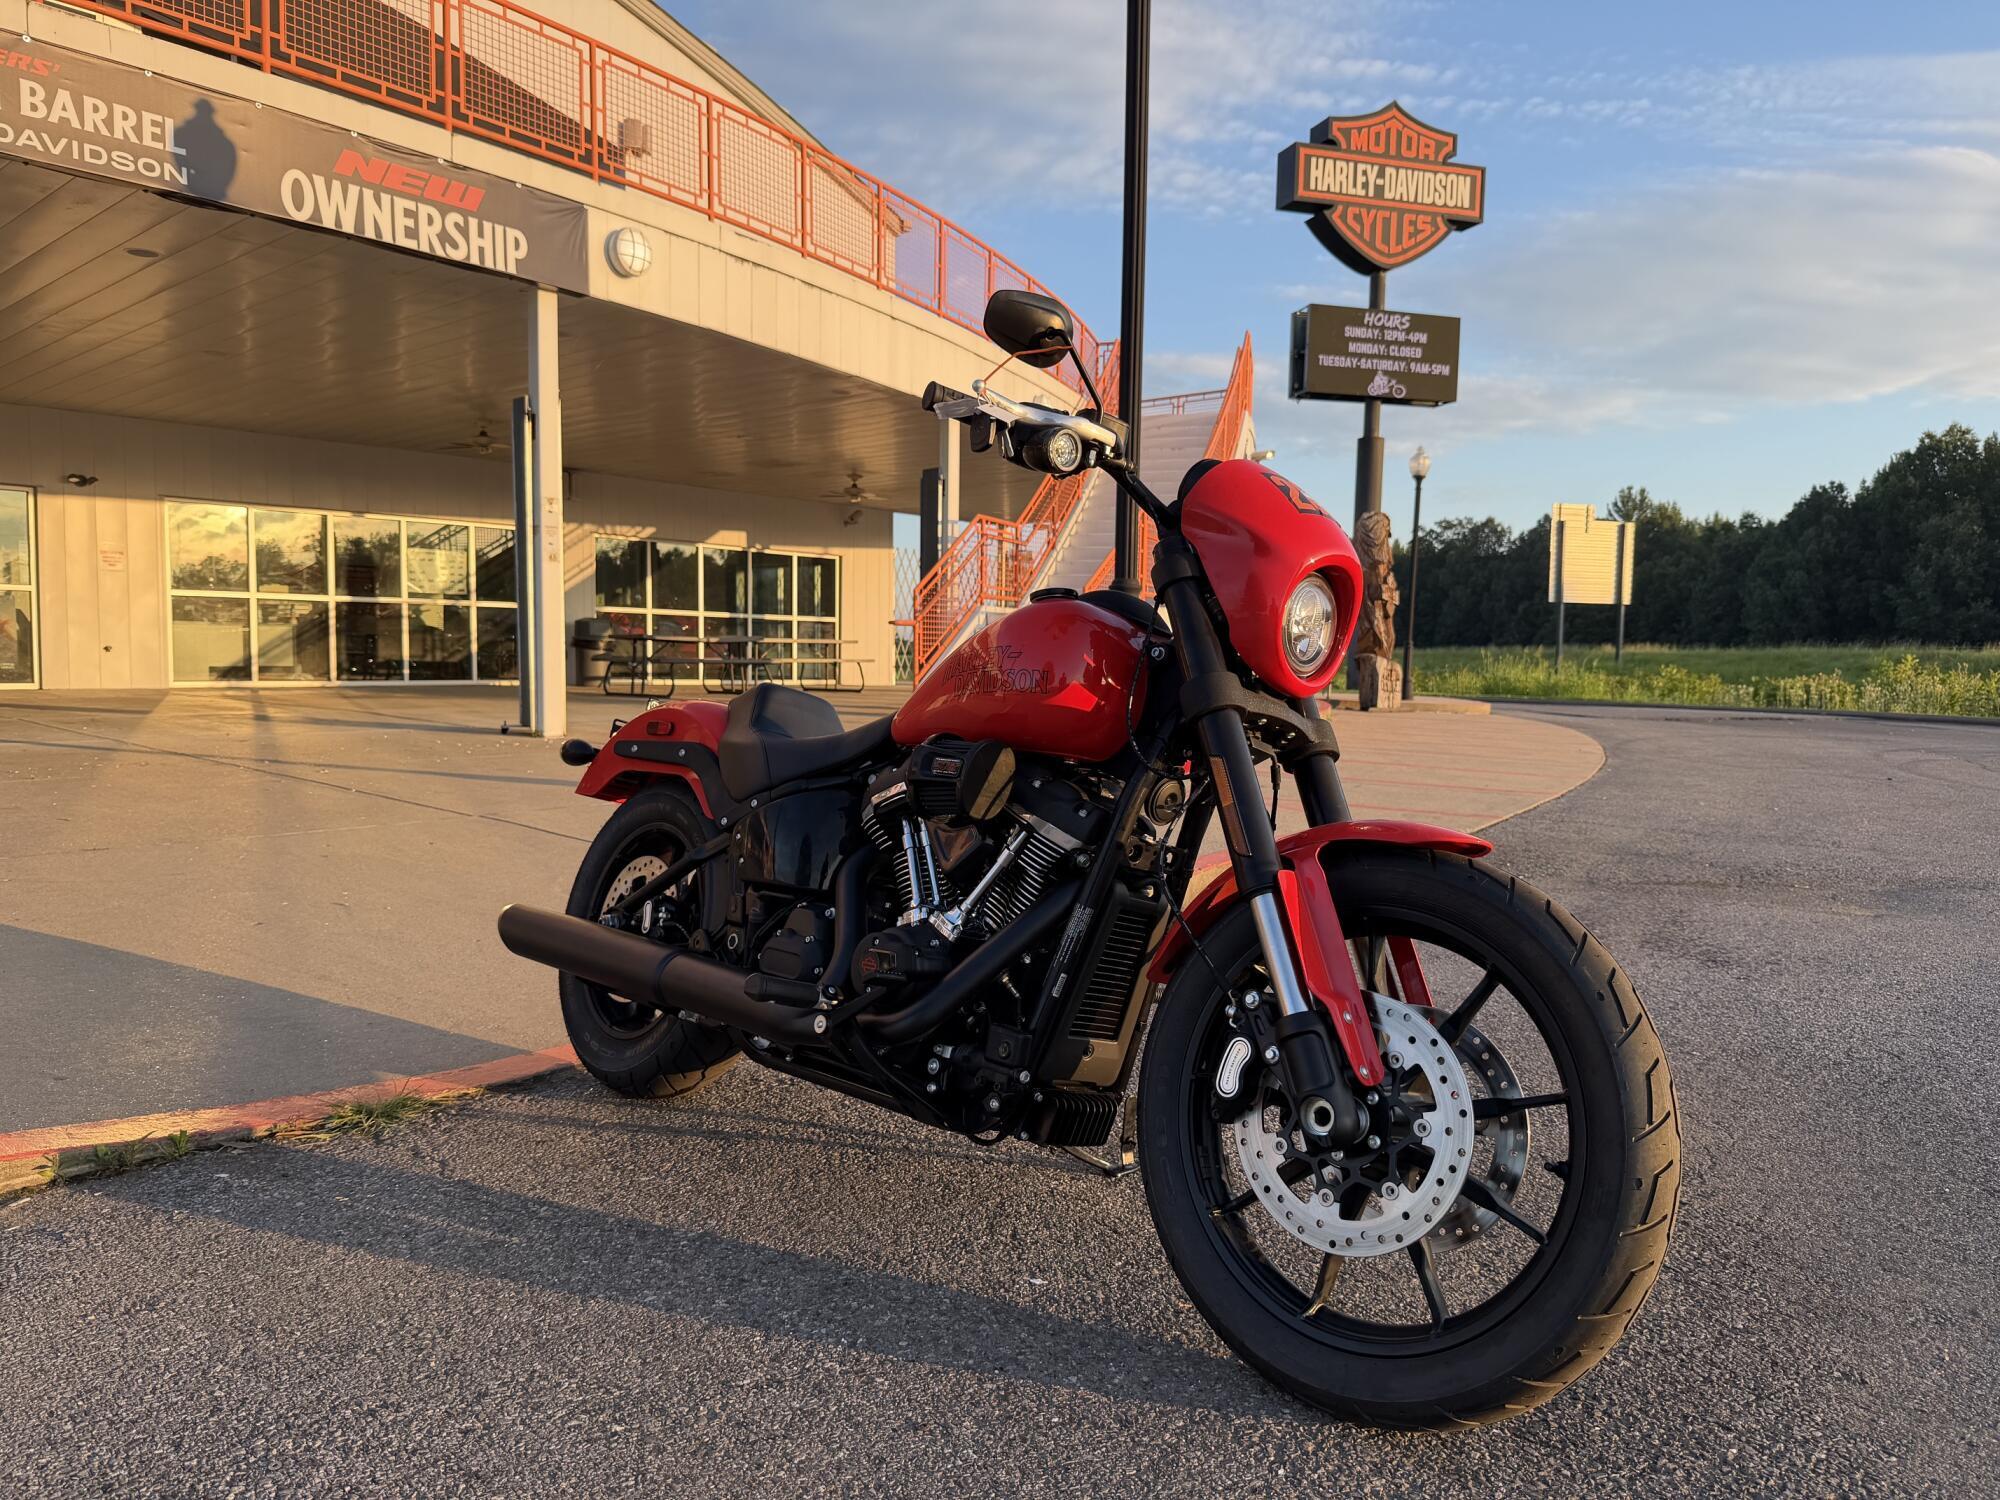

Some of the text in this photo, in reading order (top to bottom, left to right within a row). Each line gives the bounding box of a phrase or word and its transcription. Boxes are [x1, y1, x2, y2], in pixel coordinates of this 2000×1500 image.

[19, 78, 187, 156] BARREL
[1350, 119, 1436, 161] MOTOR
[333, 149, 486, 213] NEW
[1309, 156, 1471, 209] HARLEY-DAVIDSON
[280, 168, 528, 275] OWNERSHIP
[1346, 206, 1433, 254] CYCLES
[1344, 326, 1427, 344] SUNDAY: 12PM-4PM
[1363, 312, 1411, 329] HOURS
[1318, 354, 1451, 377] TUESDAY-SATURDAY: 9AM-5PM
[1348, 341, 1422, 358] MONDAY: CLOSED
[951, 668, 1049, 698] DAVIDSON
